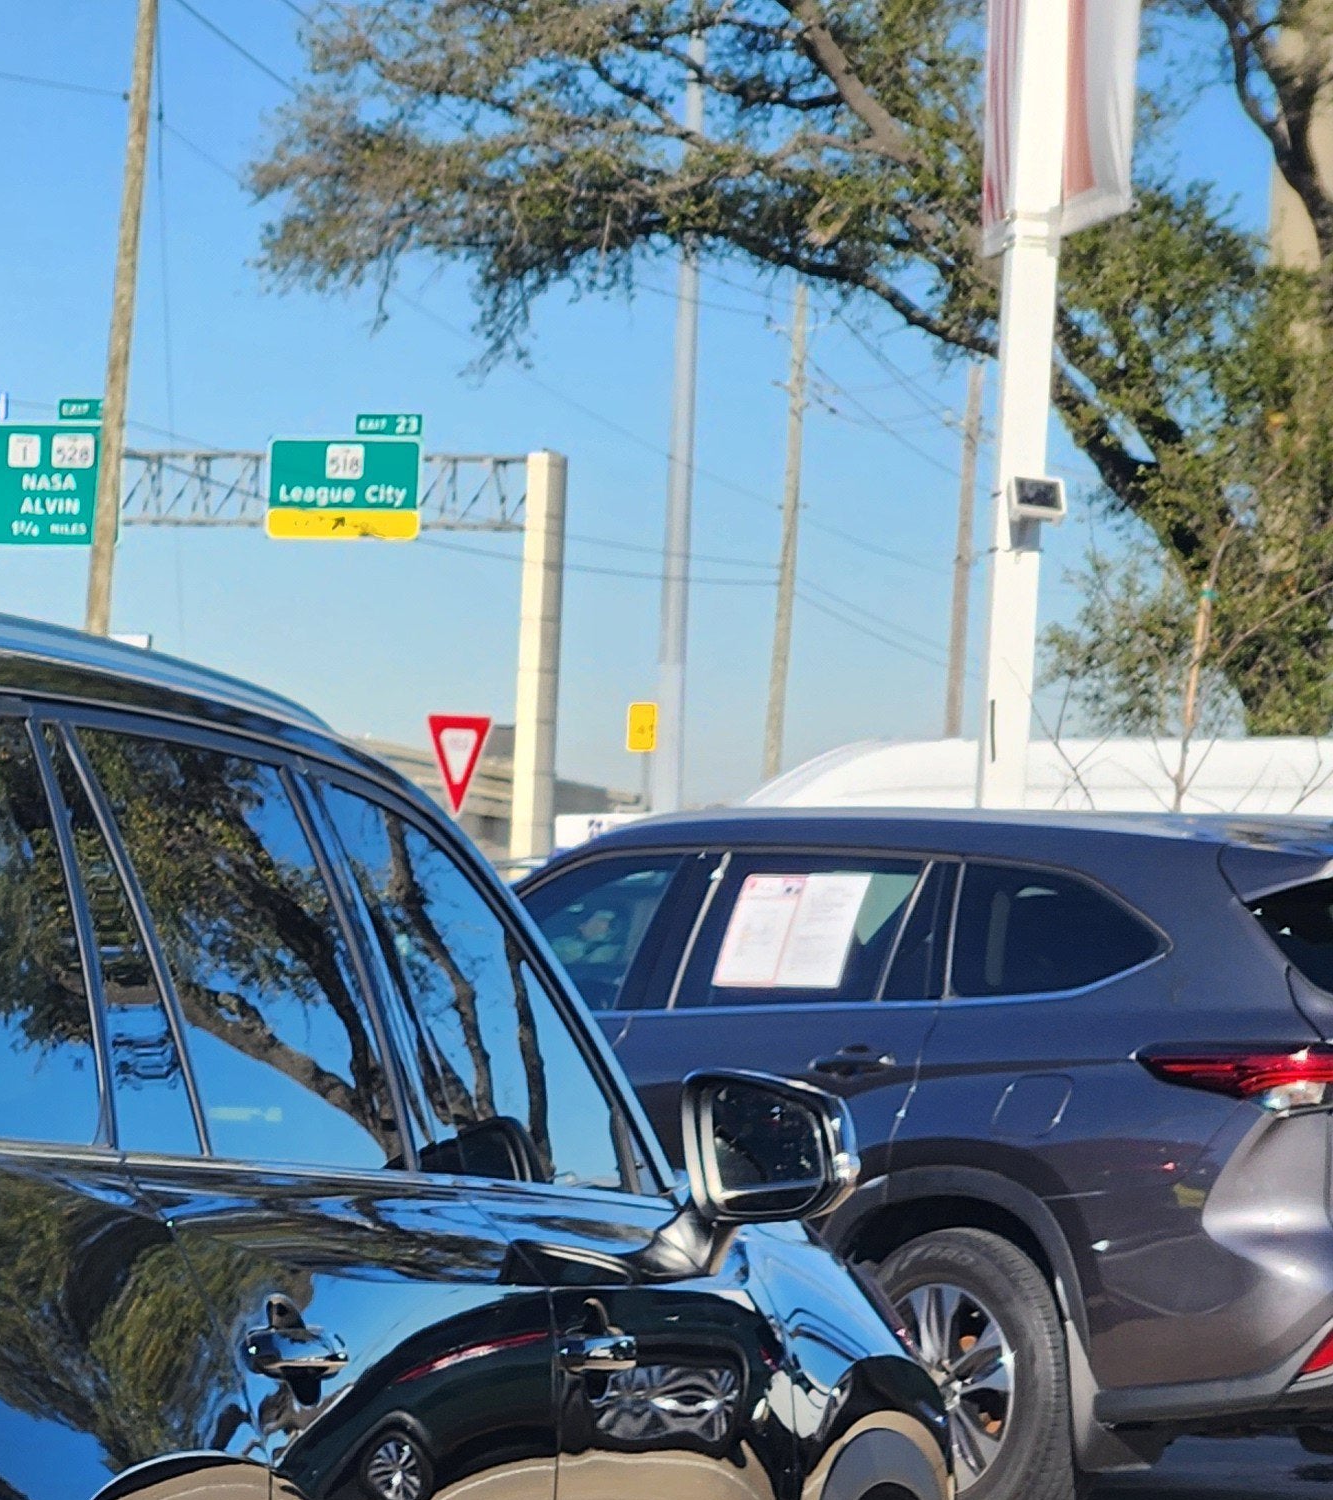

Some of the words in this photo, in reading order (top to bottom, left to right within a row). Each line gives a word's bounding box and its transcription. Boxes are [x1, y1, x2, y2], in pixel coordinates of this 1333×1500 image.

[395, 415, 420, 434] 23
[21, 472, 77, 492] NASA
[279, 483, 356, 507] League
[364, 483, 408, 508] City
[19, 496, 81, 516] ALVIN
